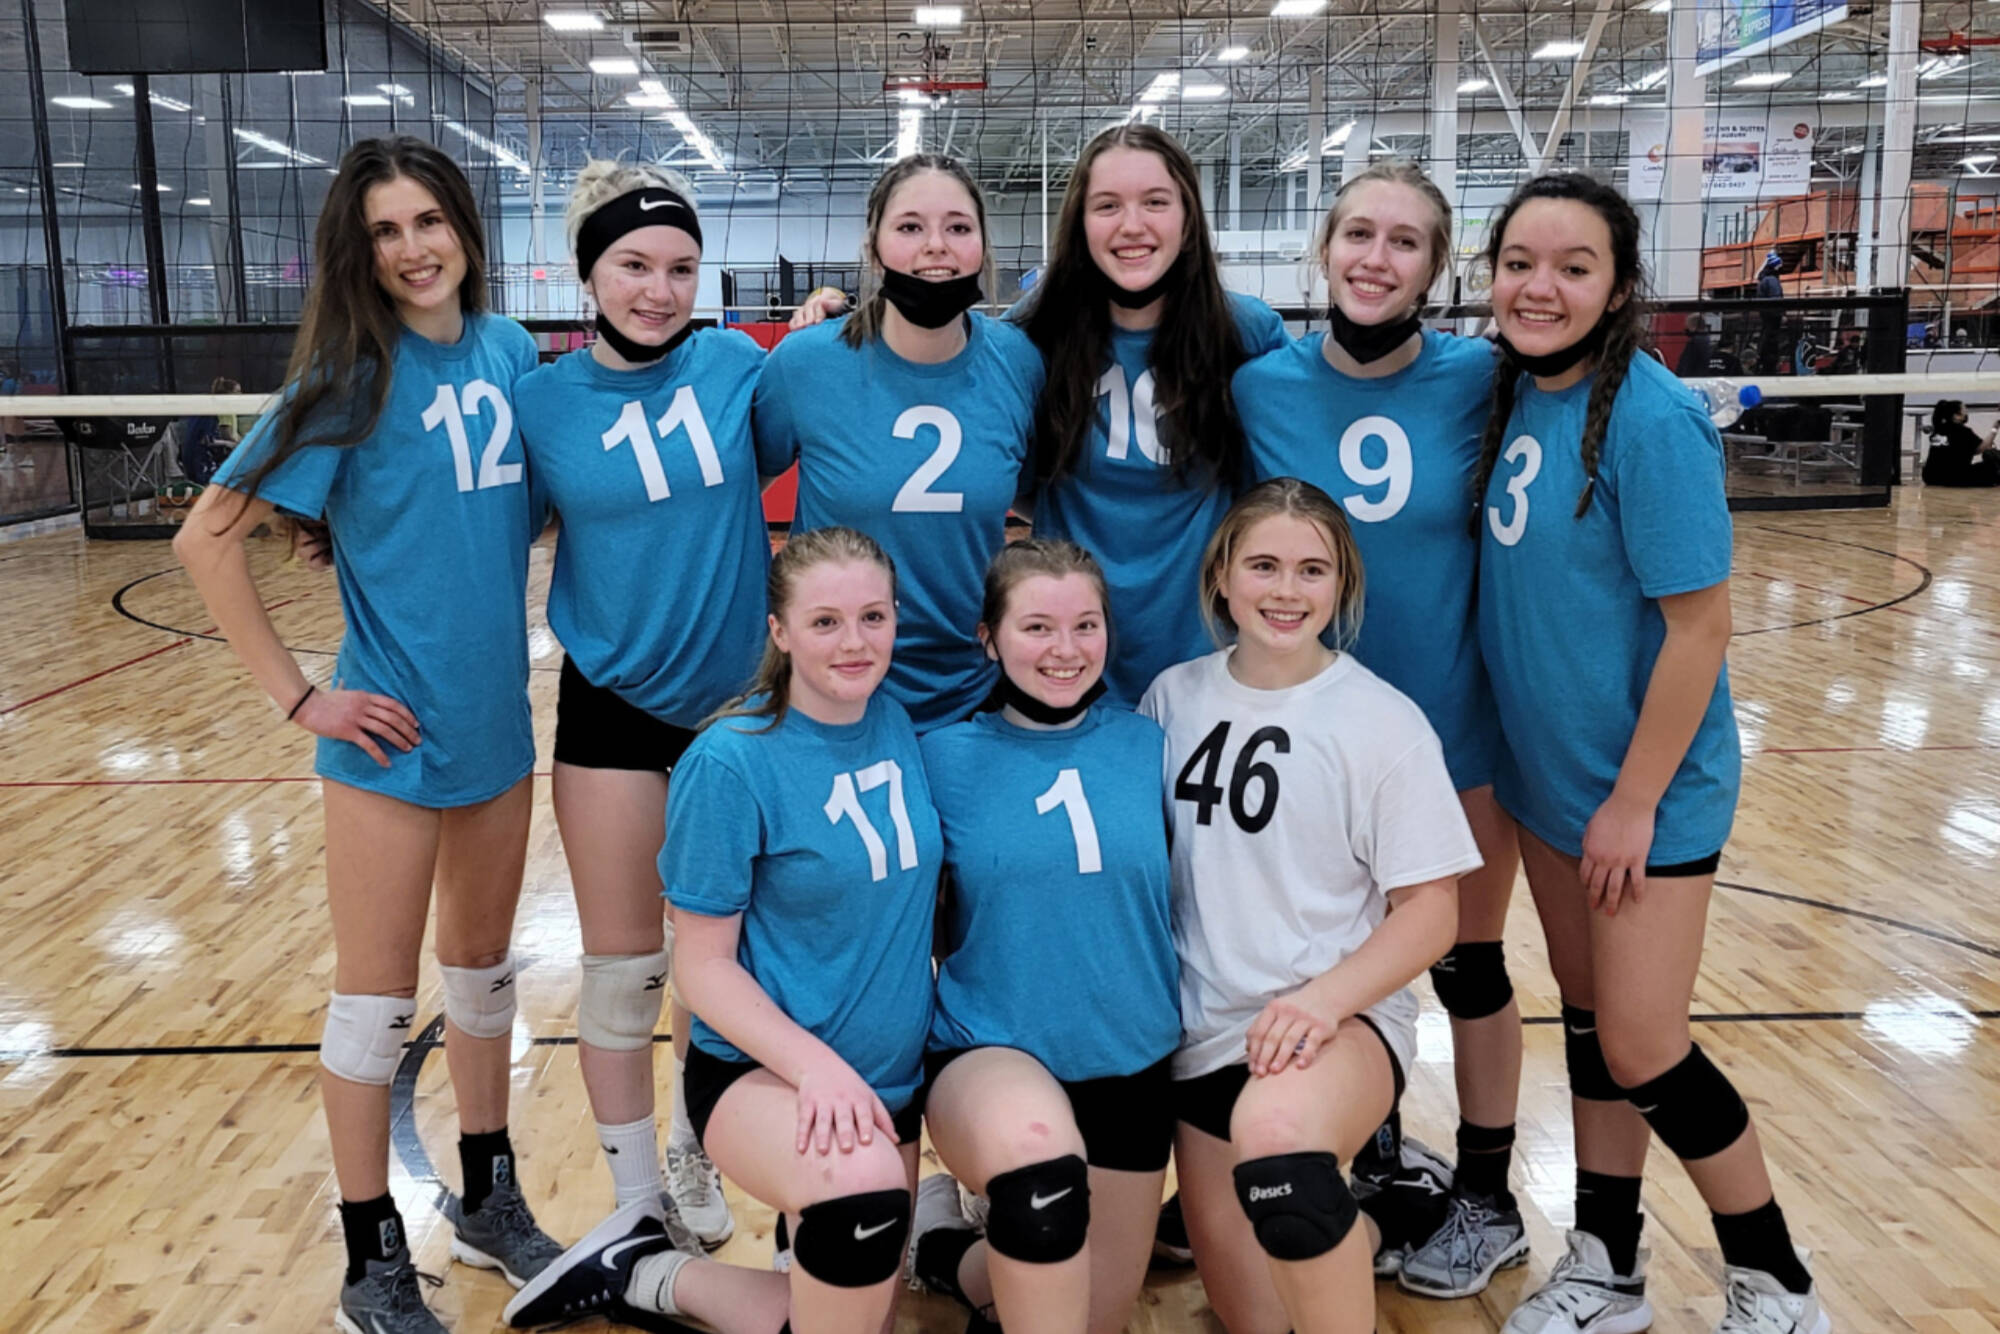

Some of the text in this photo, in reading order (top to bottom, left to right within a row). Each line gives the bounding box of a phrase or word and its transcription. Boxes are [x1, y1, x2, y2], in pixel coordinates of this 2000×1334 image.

[420, 378, 523, 493] 12
[601, 384, 725, 502] 11
[891, 404, 964, 513] 2
[1338, 415, 1413, 523] 9
[1488, 434, 1542, 546] 3
[823, 759, 918, 882] 17
[1035, 768, 1102, 874] 1
[1174, 720, 1291, 834] 46
